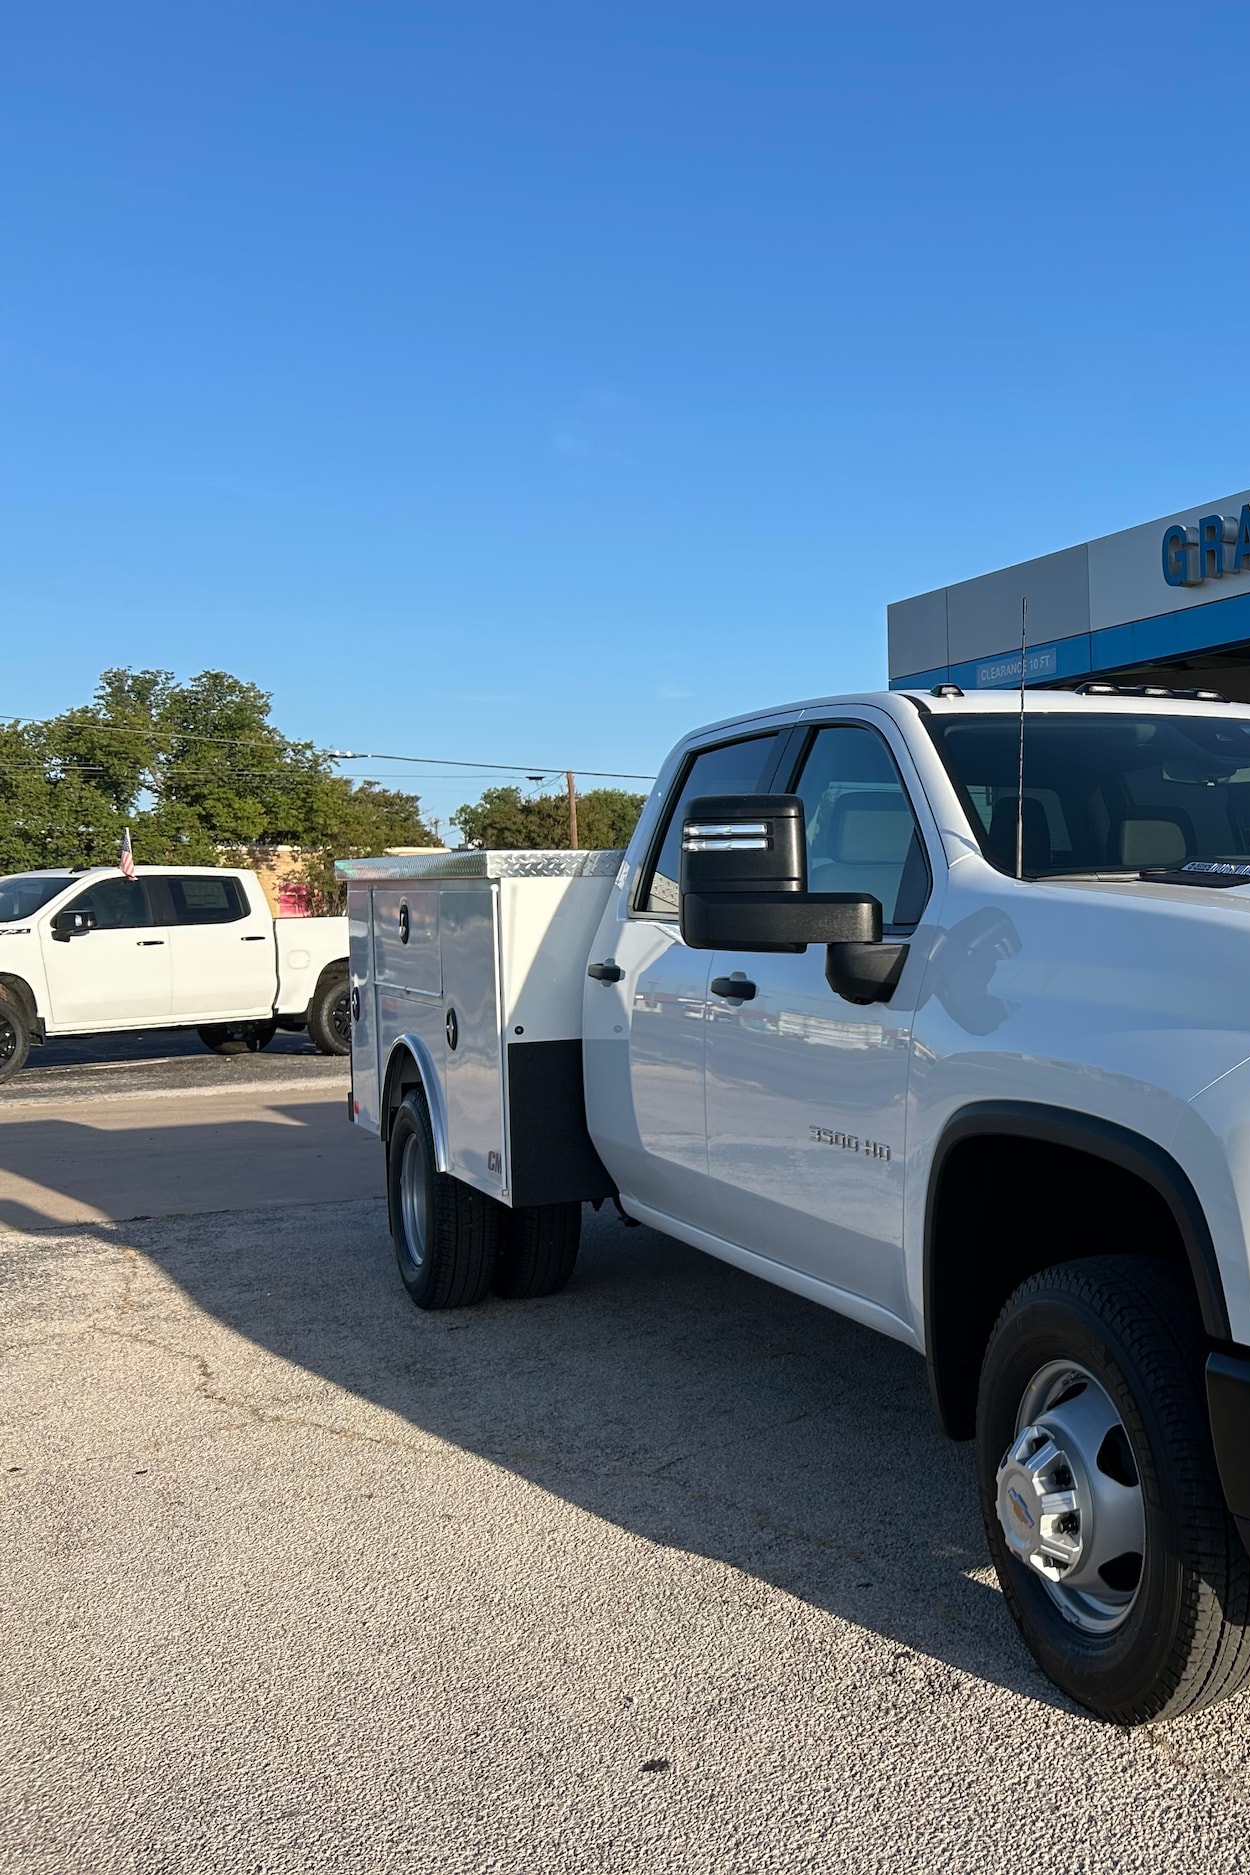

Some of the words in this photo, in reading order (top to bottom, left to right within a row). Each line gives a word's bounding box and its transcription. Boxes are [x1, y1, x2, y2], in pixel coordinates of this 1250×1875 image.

[981, 662, 1027, 680] CLEARANCE
[1029, 659, 1039, 671] 10
[1040, 655, 1050, 668] FT
